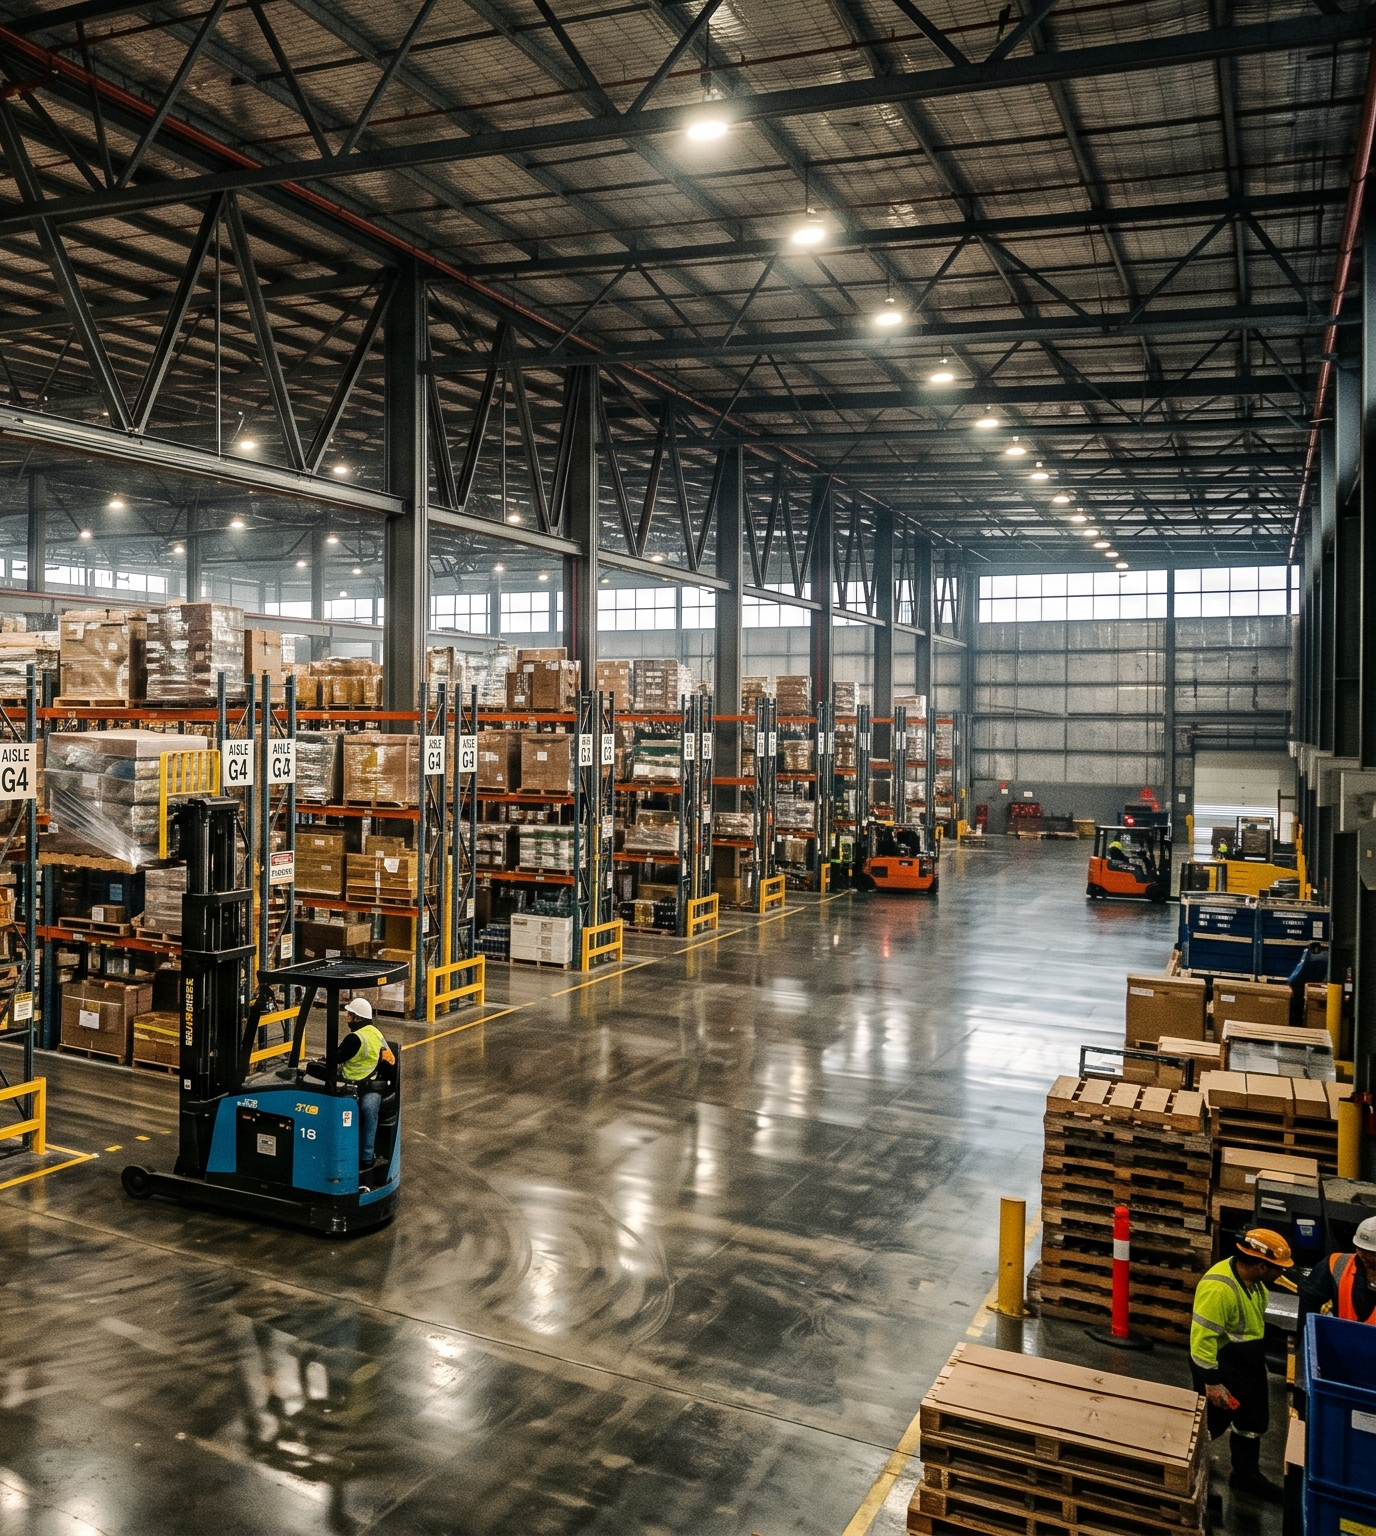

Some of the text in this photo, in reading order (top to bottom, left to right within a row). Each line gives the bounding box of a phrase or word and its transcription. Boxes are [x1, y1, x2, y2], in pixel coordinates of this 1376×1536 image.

[1, 748, 30, 762] AISLE
[229, 744, 249, 756] AISLE
[229, 759, 248, 780] G4
[1, 767, 29, 793] G4
[300, 1127, 317, 1140] 18
